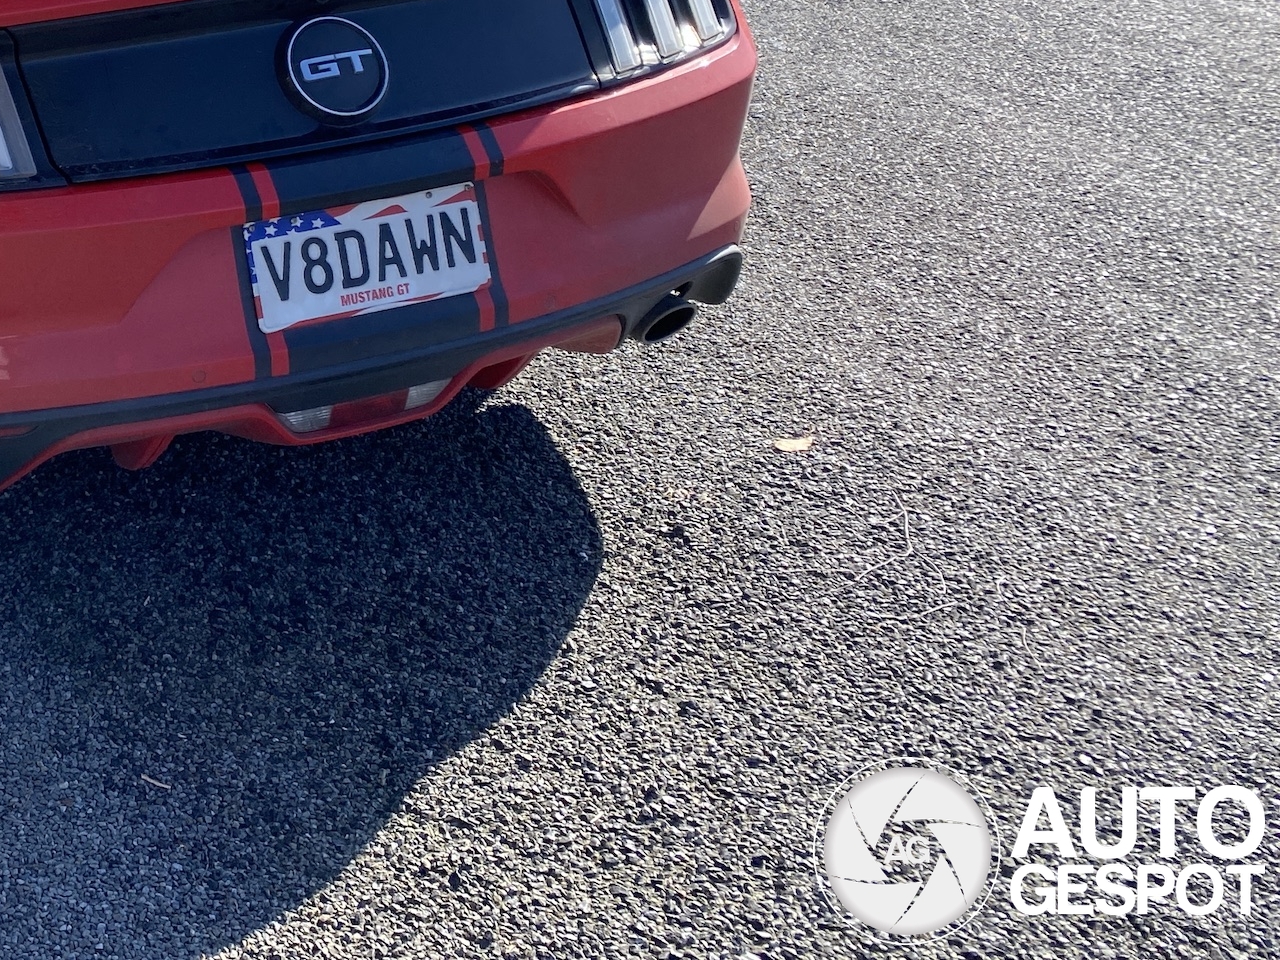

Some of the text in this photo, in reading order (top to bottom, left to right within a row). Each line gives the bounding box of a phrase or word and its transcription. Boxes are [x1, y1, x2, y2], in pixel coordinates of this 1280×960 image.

[299, 48, 373, 82] GT
[261, 208, 477, 302] V8DAWN
[340, 283, 410, 307] MUSTANG GT
